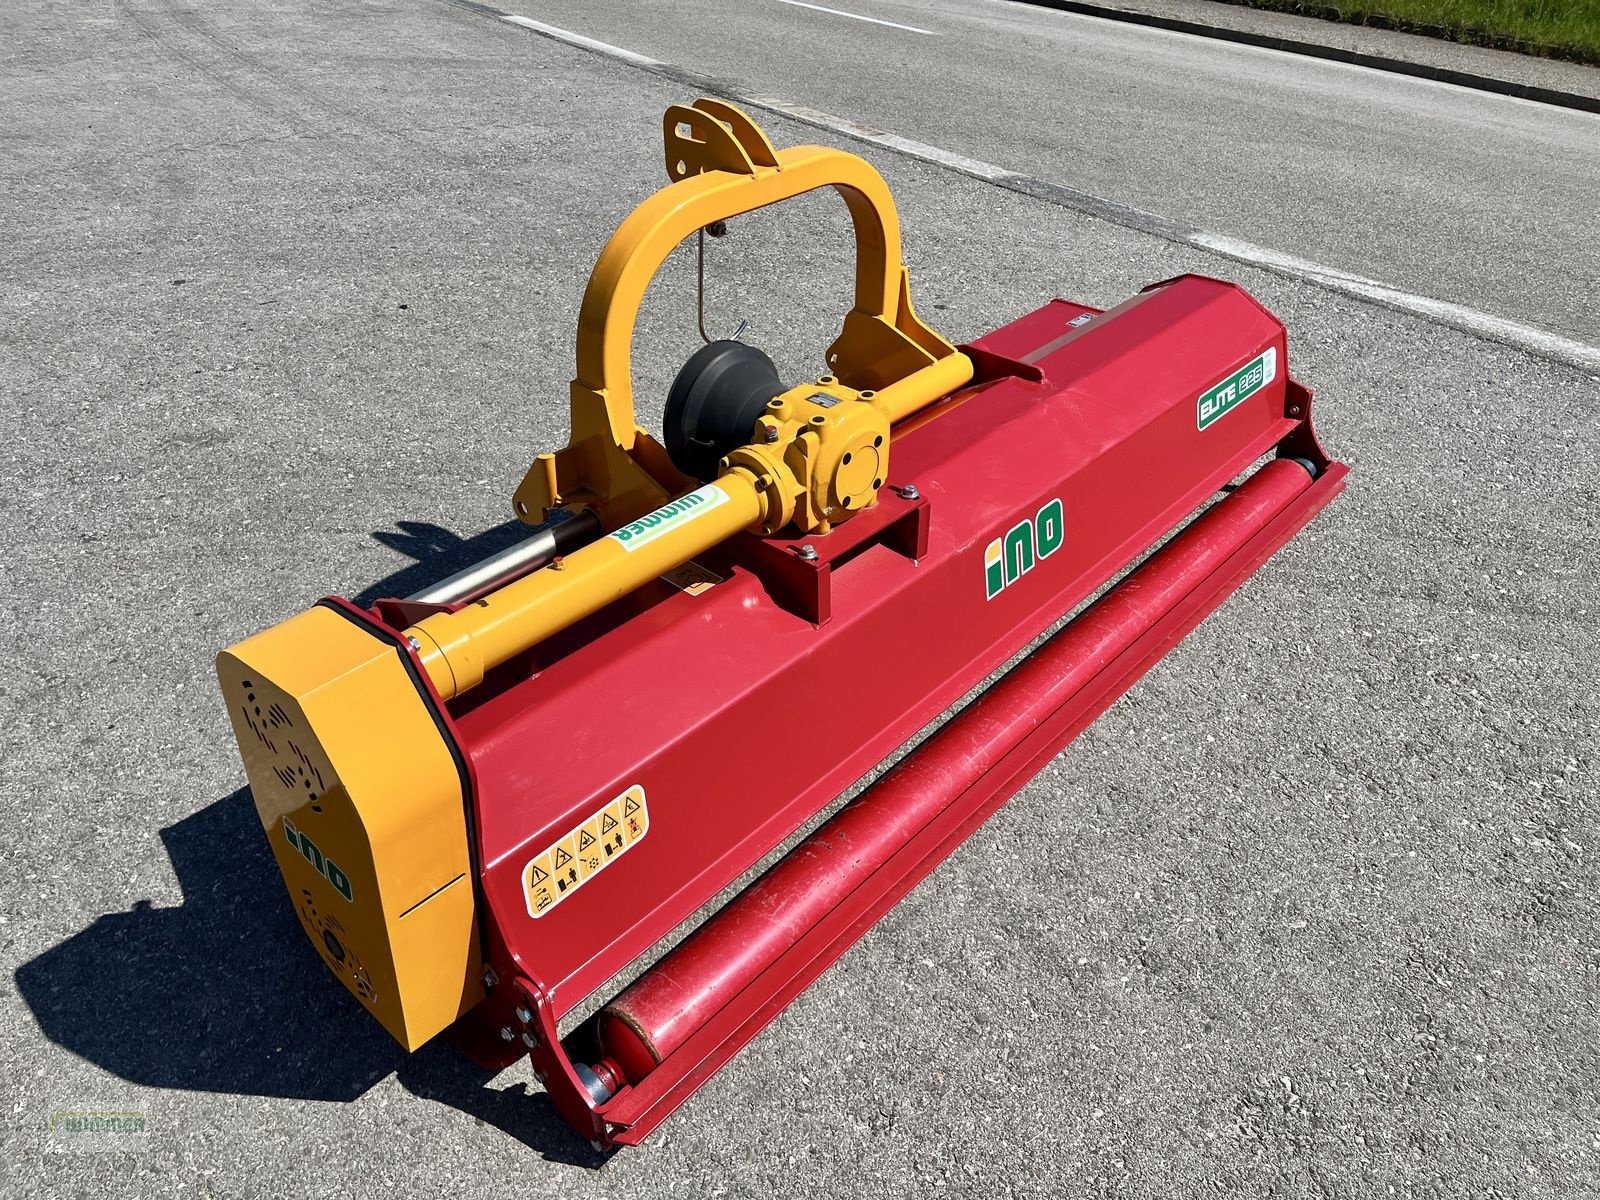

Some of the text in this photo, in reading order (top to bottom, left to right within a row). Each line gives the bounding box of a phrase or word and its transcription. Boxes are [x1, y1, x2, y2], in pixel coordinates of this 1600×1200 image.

[1200, 382, 1236, 422] ELITE
[1239, 363, 1262, 395] 225
[611, 494, 705, 541] WIMMER
